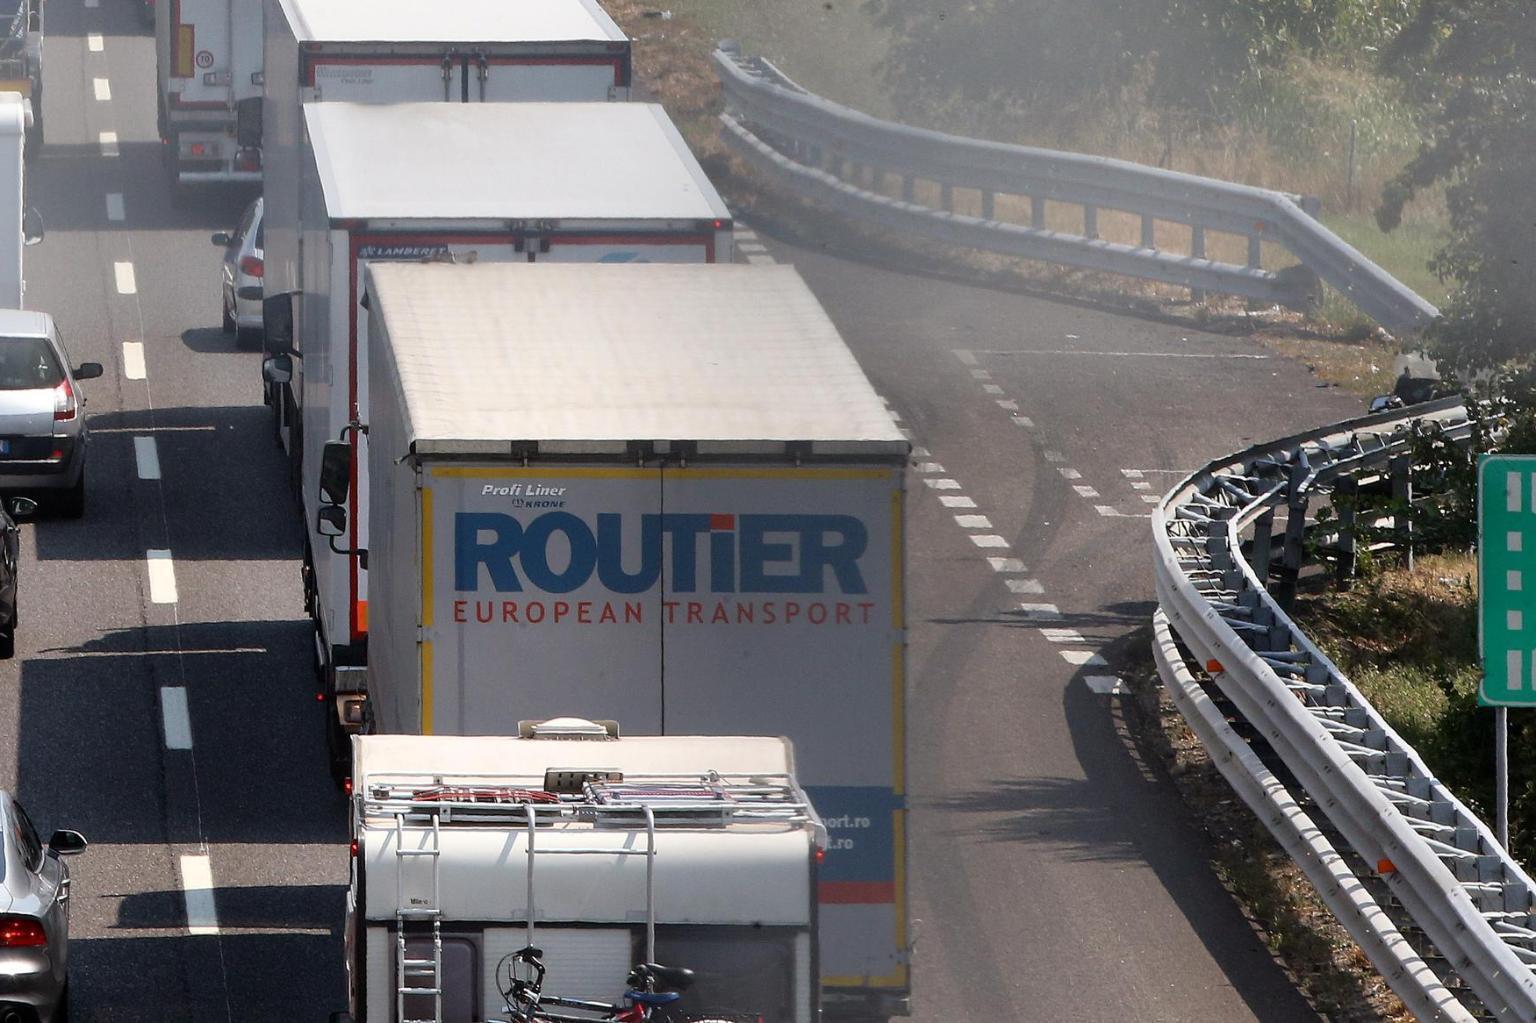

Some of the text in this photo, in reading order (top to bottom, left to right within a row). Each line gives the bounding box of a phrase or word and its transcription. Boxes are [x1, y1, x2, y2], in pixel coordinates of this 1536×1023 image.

[482, 484, 566, 496] Profi Liner
[526, 500, 566, 508] KRONE
[454, 600, 875, 625] EUROPEAN TRANSPORT
